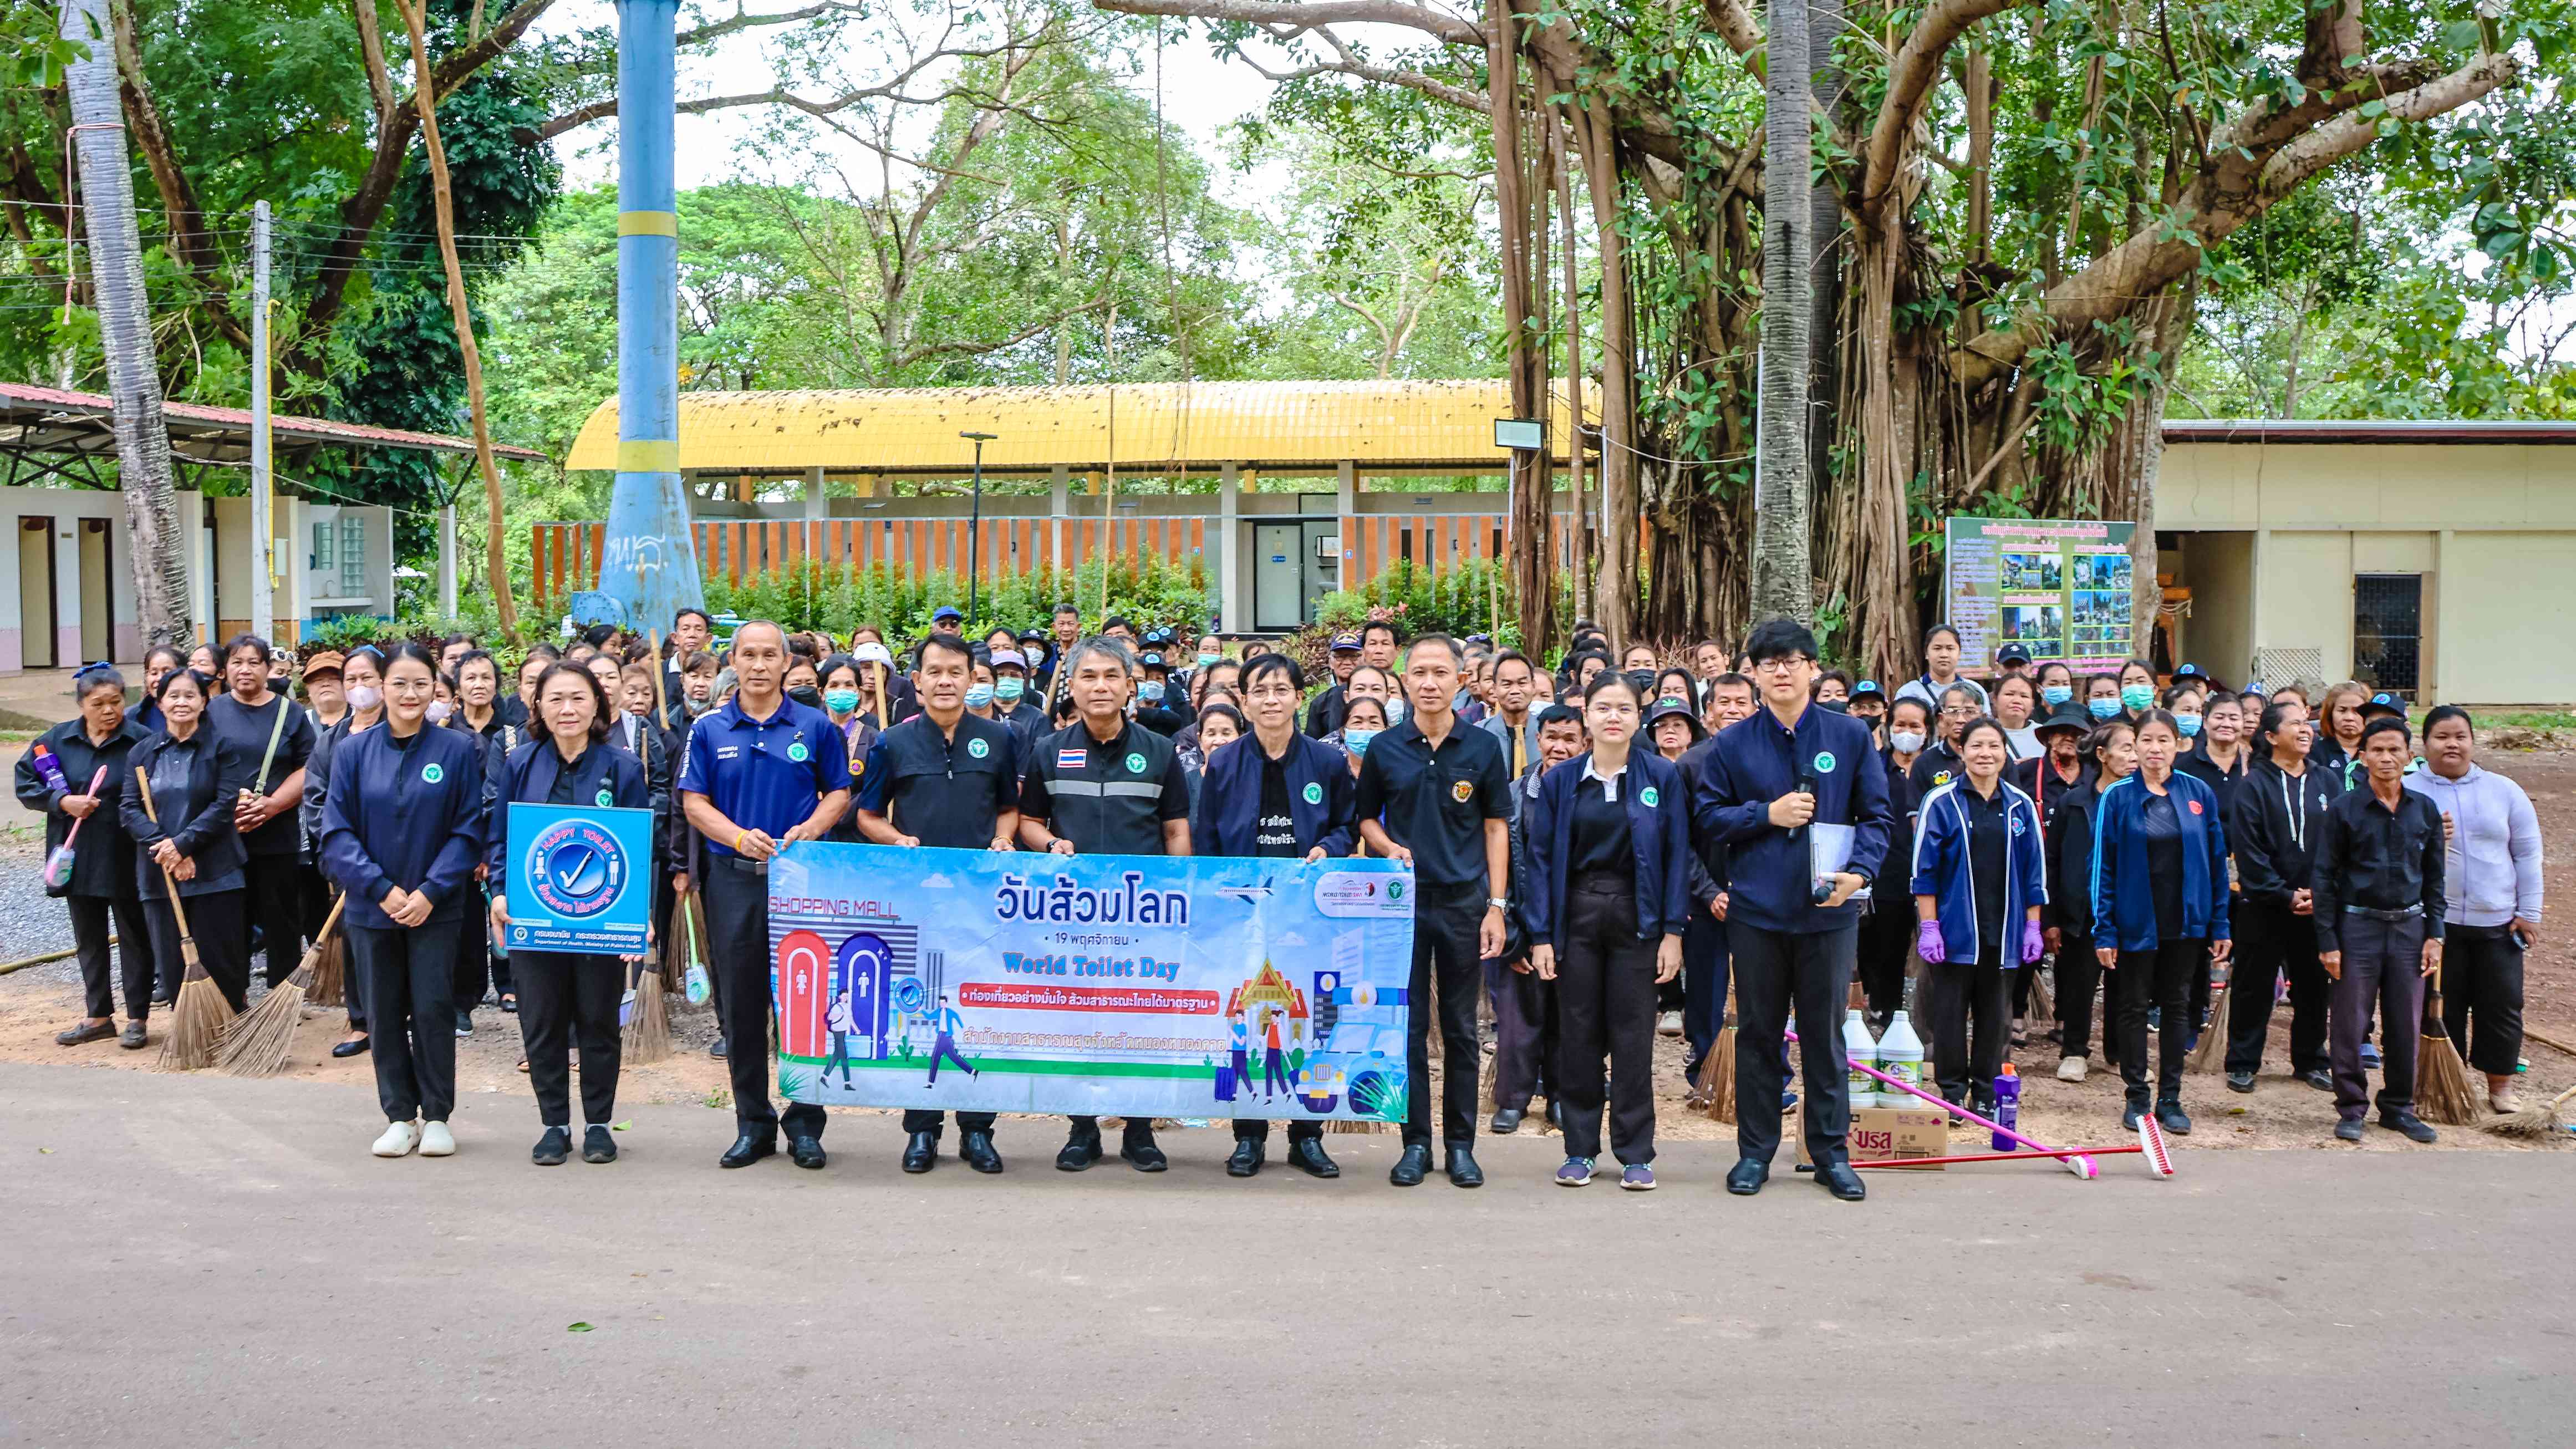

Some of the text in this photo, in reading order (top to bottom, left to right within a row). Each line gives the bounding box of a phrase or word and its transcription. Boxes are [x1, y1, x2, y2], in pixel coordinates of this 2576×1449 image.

[541, 827, 615, 853] HAPPY TOILET
[768, 896, 899, 917] SHOPPING MALL
[997, 874, 1187, 924] วันส้วมโลก
[1055, 933, 1129, 950] 19 พฤศจิกายน
[1002, 952, 1180, 982] World Toilet Day
[969, 986, 1209, 1011] ท่องเที่ยวอย่างมั่นใจ ส้วมสาธารณะไทยได้มาตรฐาน
